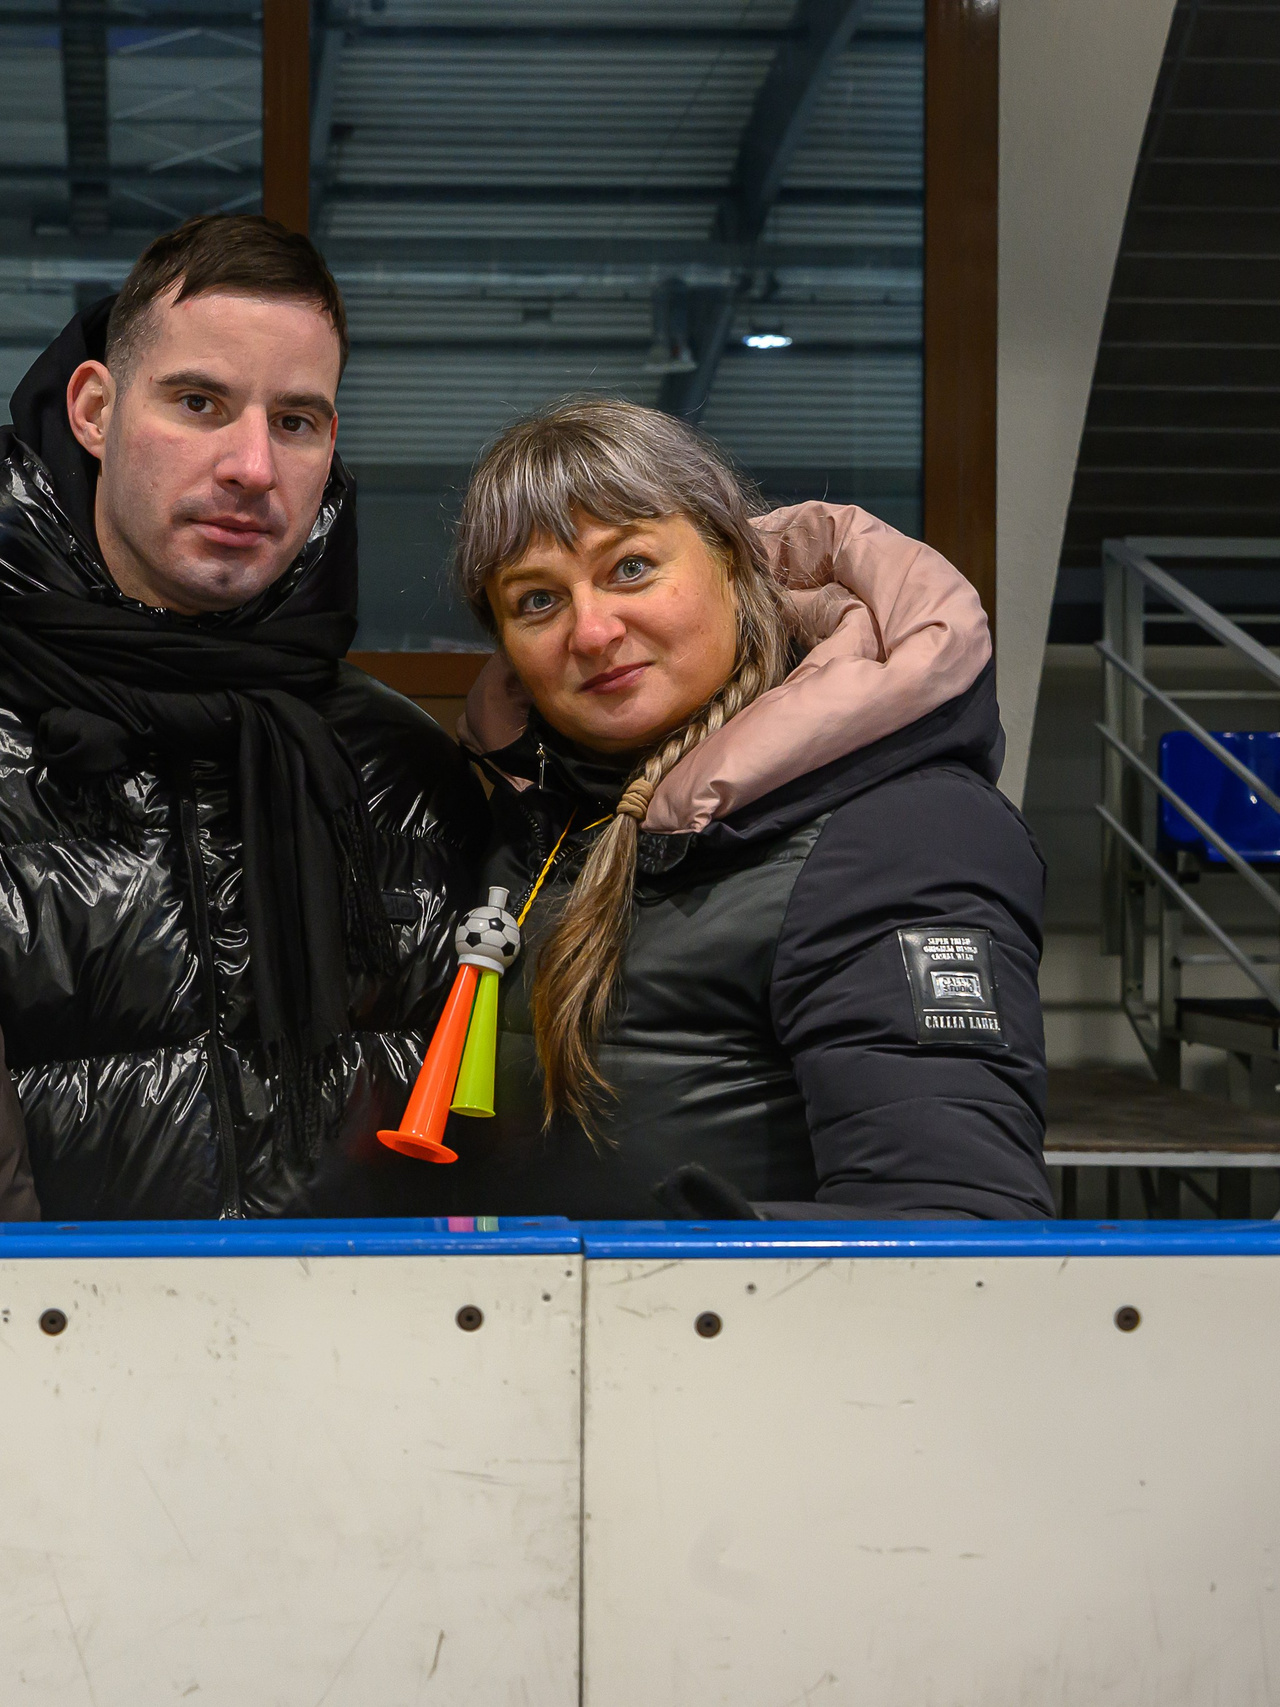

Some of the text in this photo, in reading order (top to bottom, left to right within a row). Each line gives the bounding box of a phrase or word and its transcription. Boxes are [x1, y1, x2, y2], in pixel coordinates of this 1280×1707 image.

[943, 985, 975, 993] STUDIO
[925, 1015, 1001, 1031] CALLIA LABEL
